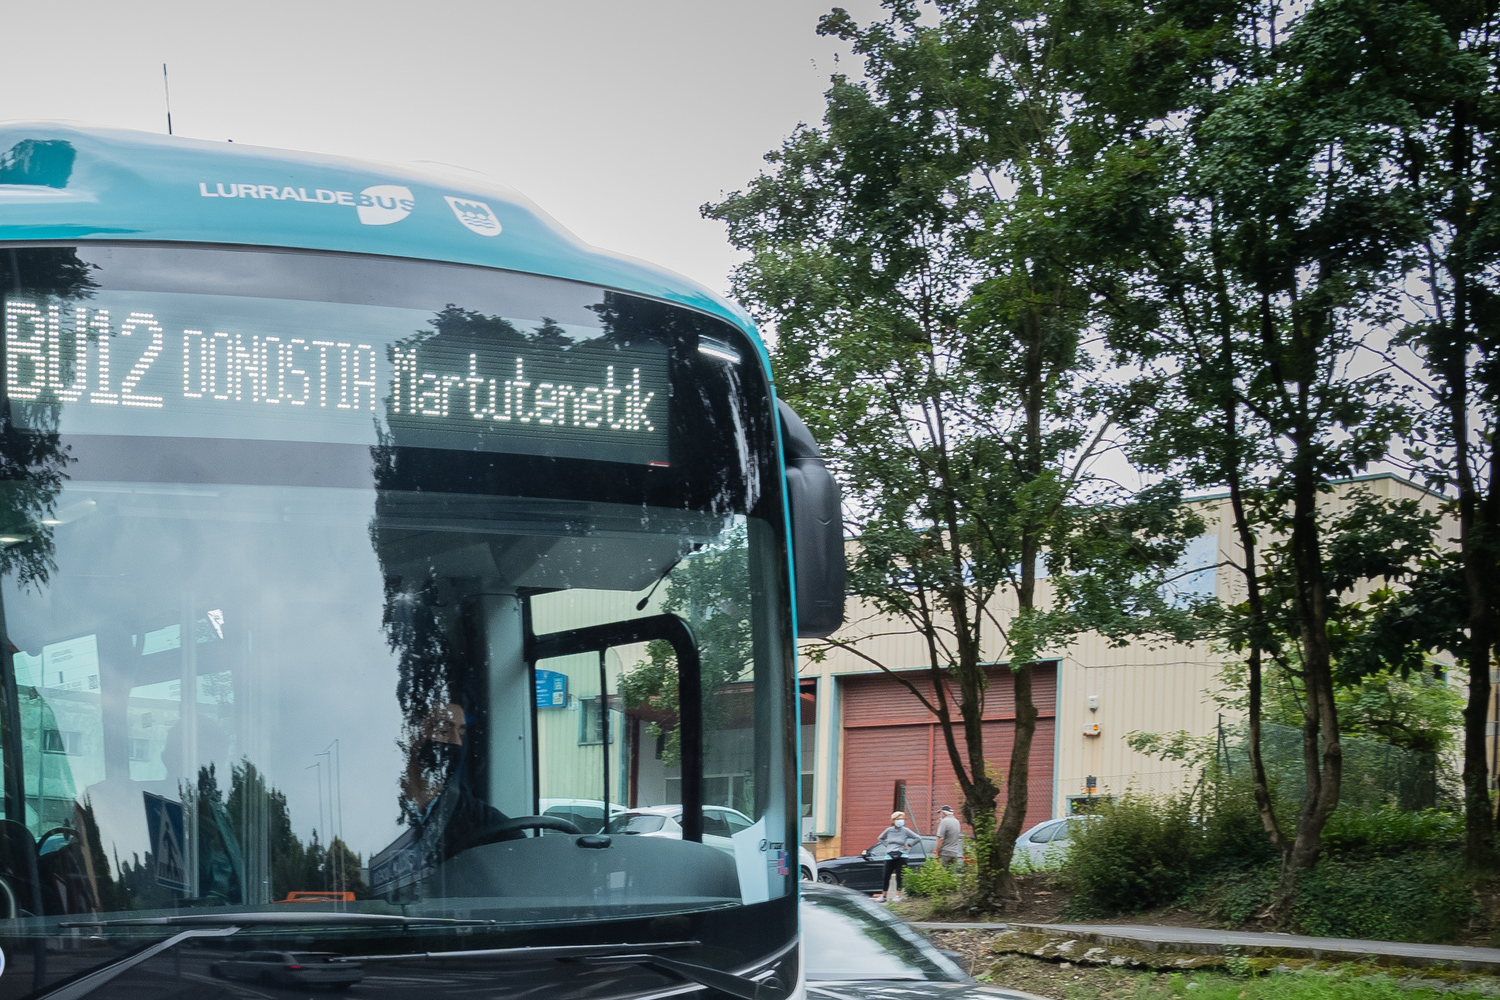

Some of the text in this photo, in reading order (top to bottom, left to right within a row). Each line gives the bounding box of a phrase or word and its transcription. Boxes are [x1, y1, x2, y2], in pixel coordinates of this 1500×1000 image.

[6, 301, 655, 431] BU12 DONOSTIA Martutenetik
